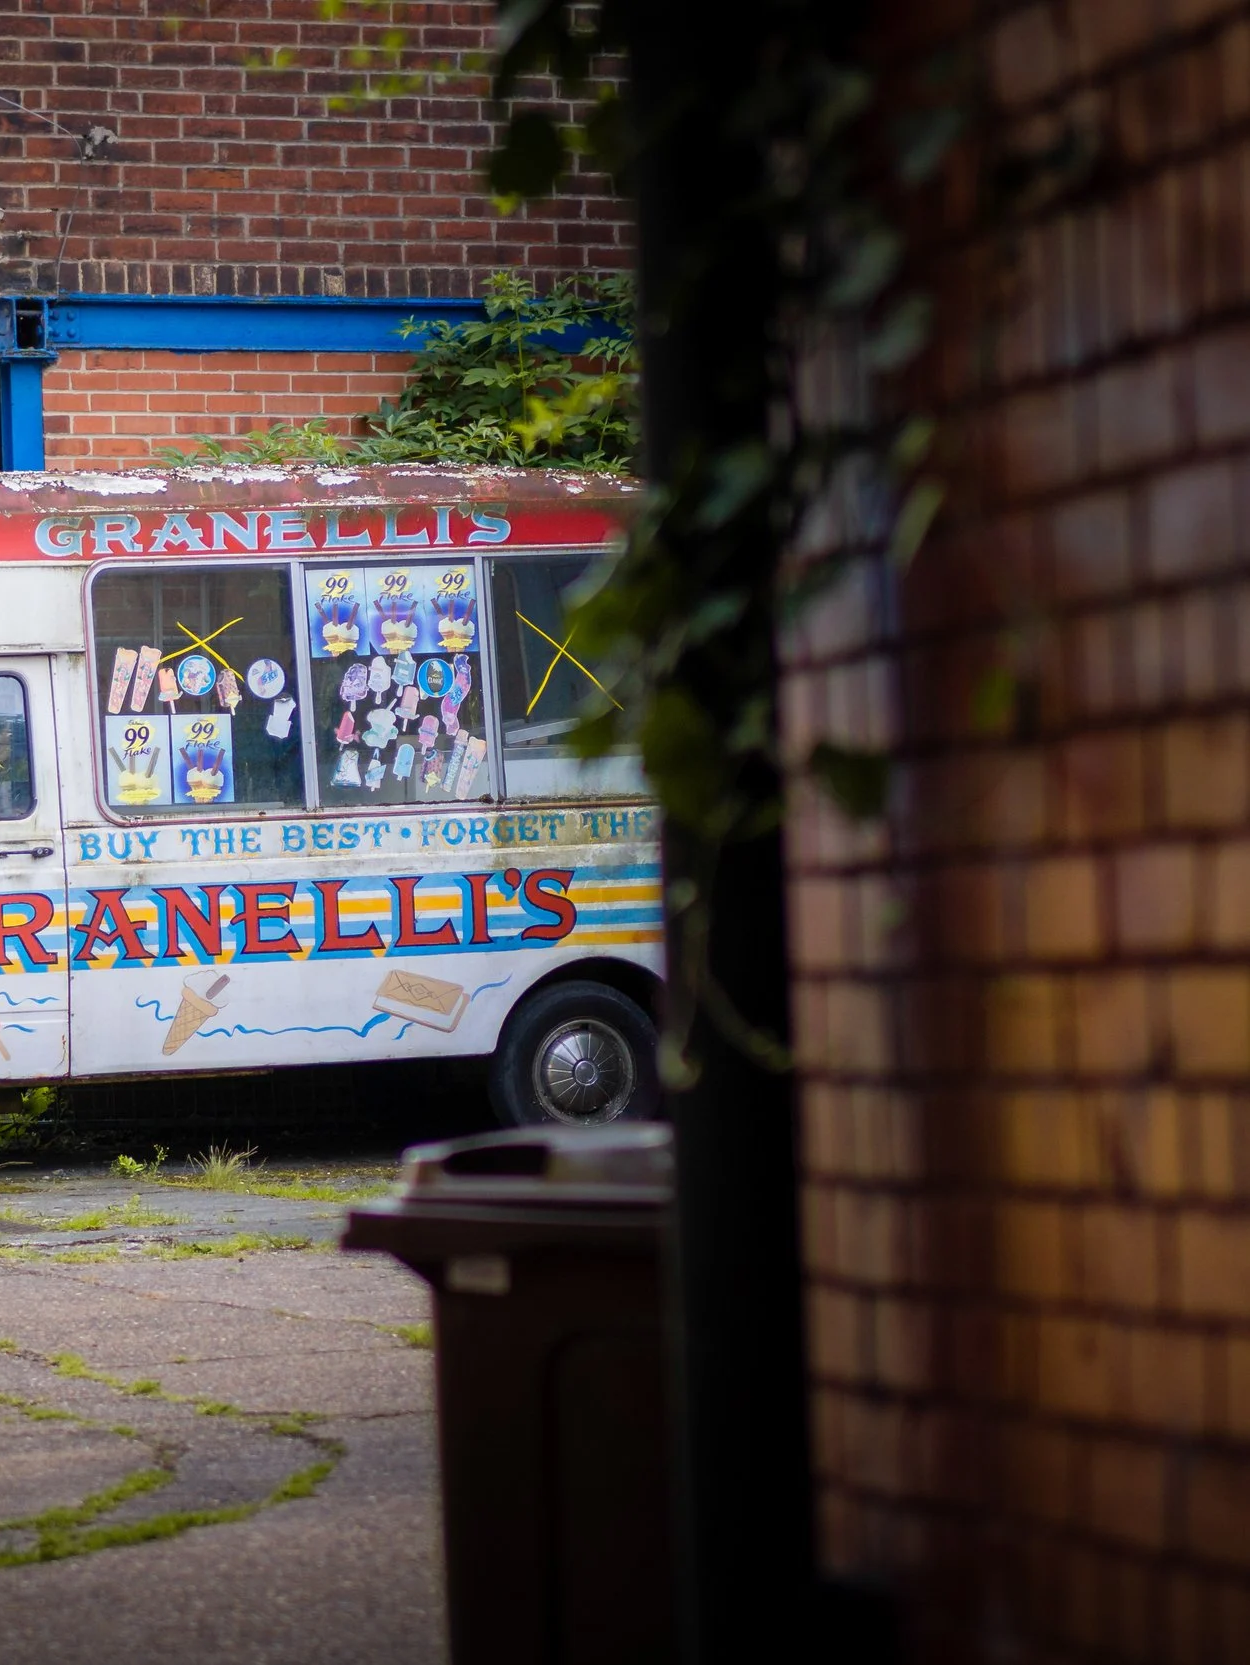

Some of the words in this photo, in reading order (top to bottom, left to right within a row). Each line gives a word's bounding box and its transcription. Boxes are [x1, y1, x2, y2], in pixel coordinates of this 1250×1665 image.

[34, 502, 512, 557] GRANELLI'S
[325, 576, 348, 595] 99
[385, 574, 407, 592] 99
[442, 572, 465, 590] 99
[124, 726, 150, 749] 99
[191, 721, 215, 740] 99
[78, 830, 161, 861] BUY
[181, 826, 262, 857] THE
[282, 820, 391, 852] BEST
[419, 811, 566, 847] FORGET
[582, 810, 652, 839] THE
